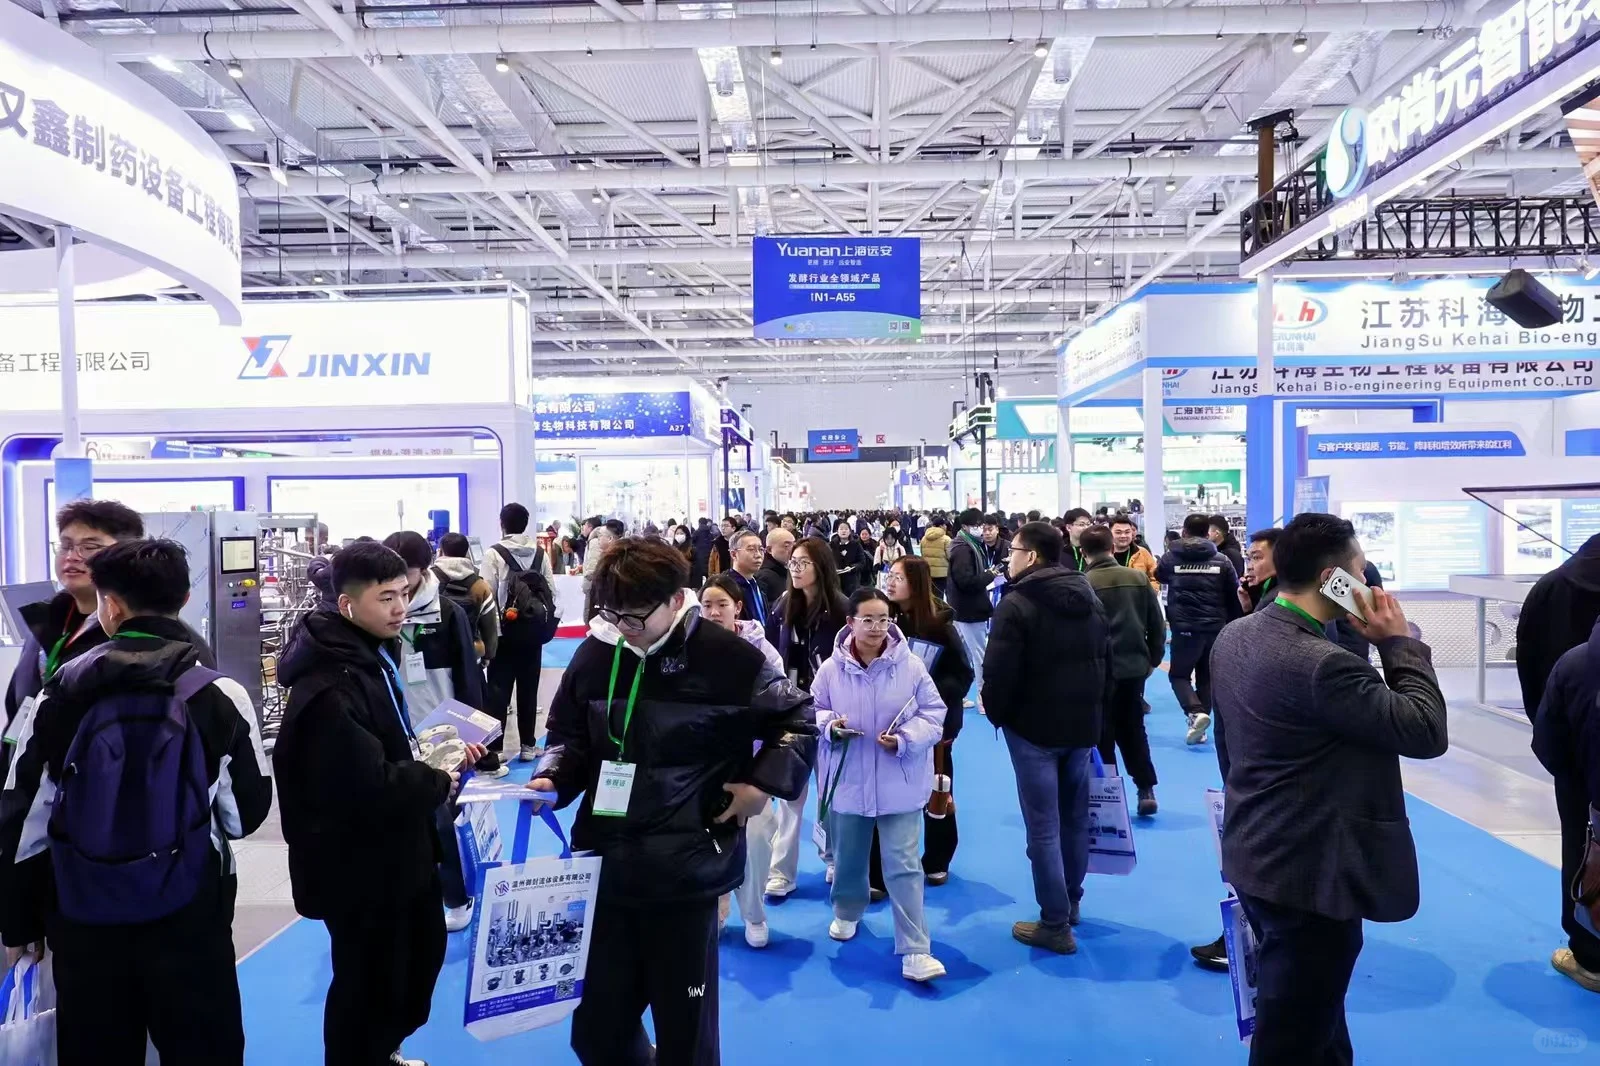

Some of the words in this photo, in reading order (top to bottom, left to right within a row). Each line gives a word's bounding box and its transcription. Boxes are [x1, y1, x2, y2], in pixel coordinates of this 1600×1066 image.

[0, 80, 240, 263] 鑫制药设备工程有限
[788, 273, 881, 283] 发酵行业全领域产品
[1361, 293, 1600, 331] 江苏科海物
[1272, 332, 1317, 341] ERUNHAI
[1361, 333, 1442, 351] JiangSu
[1452, 332, 1509, 346] Kehai
[297, 352, 431, 377] JINXIN
[1212, 361, 1593, 381] 江苏海生物工程设备有限公司
[1212, 383, 1259, 396] JiangS
[1277, 382, 1317, 392] Kehai
[1324, 379, 1442, 394] Bio-engineering
[1449, 377, 1527, 391] Equipment
[1533, 376, 1593, 388] CO.,LTD
[876, 434, 886, 444] 区
